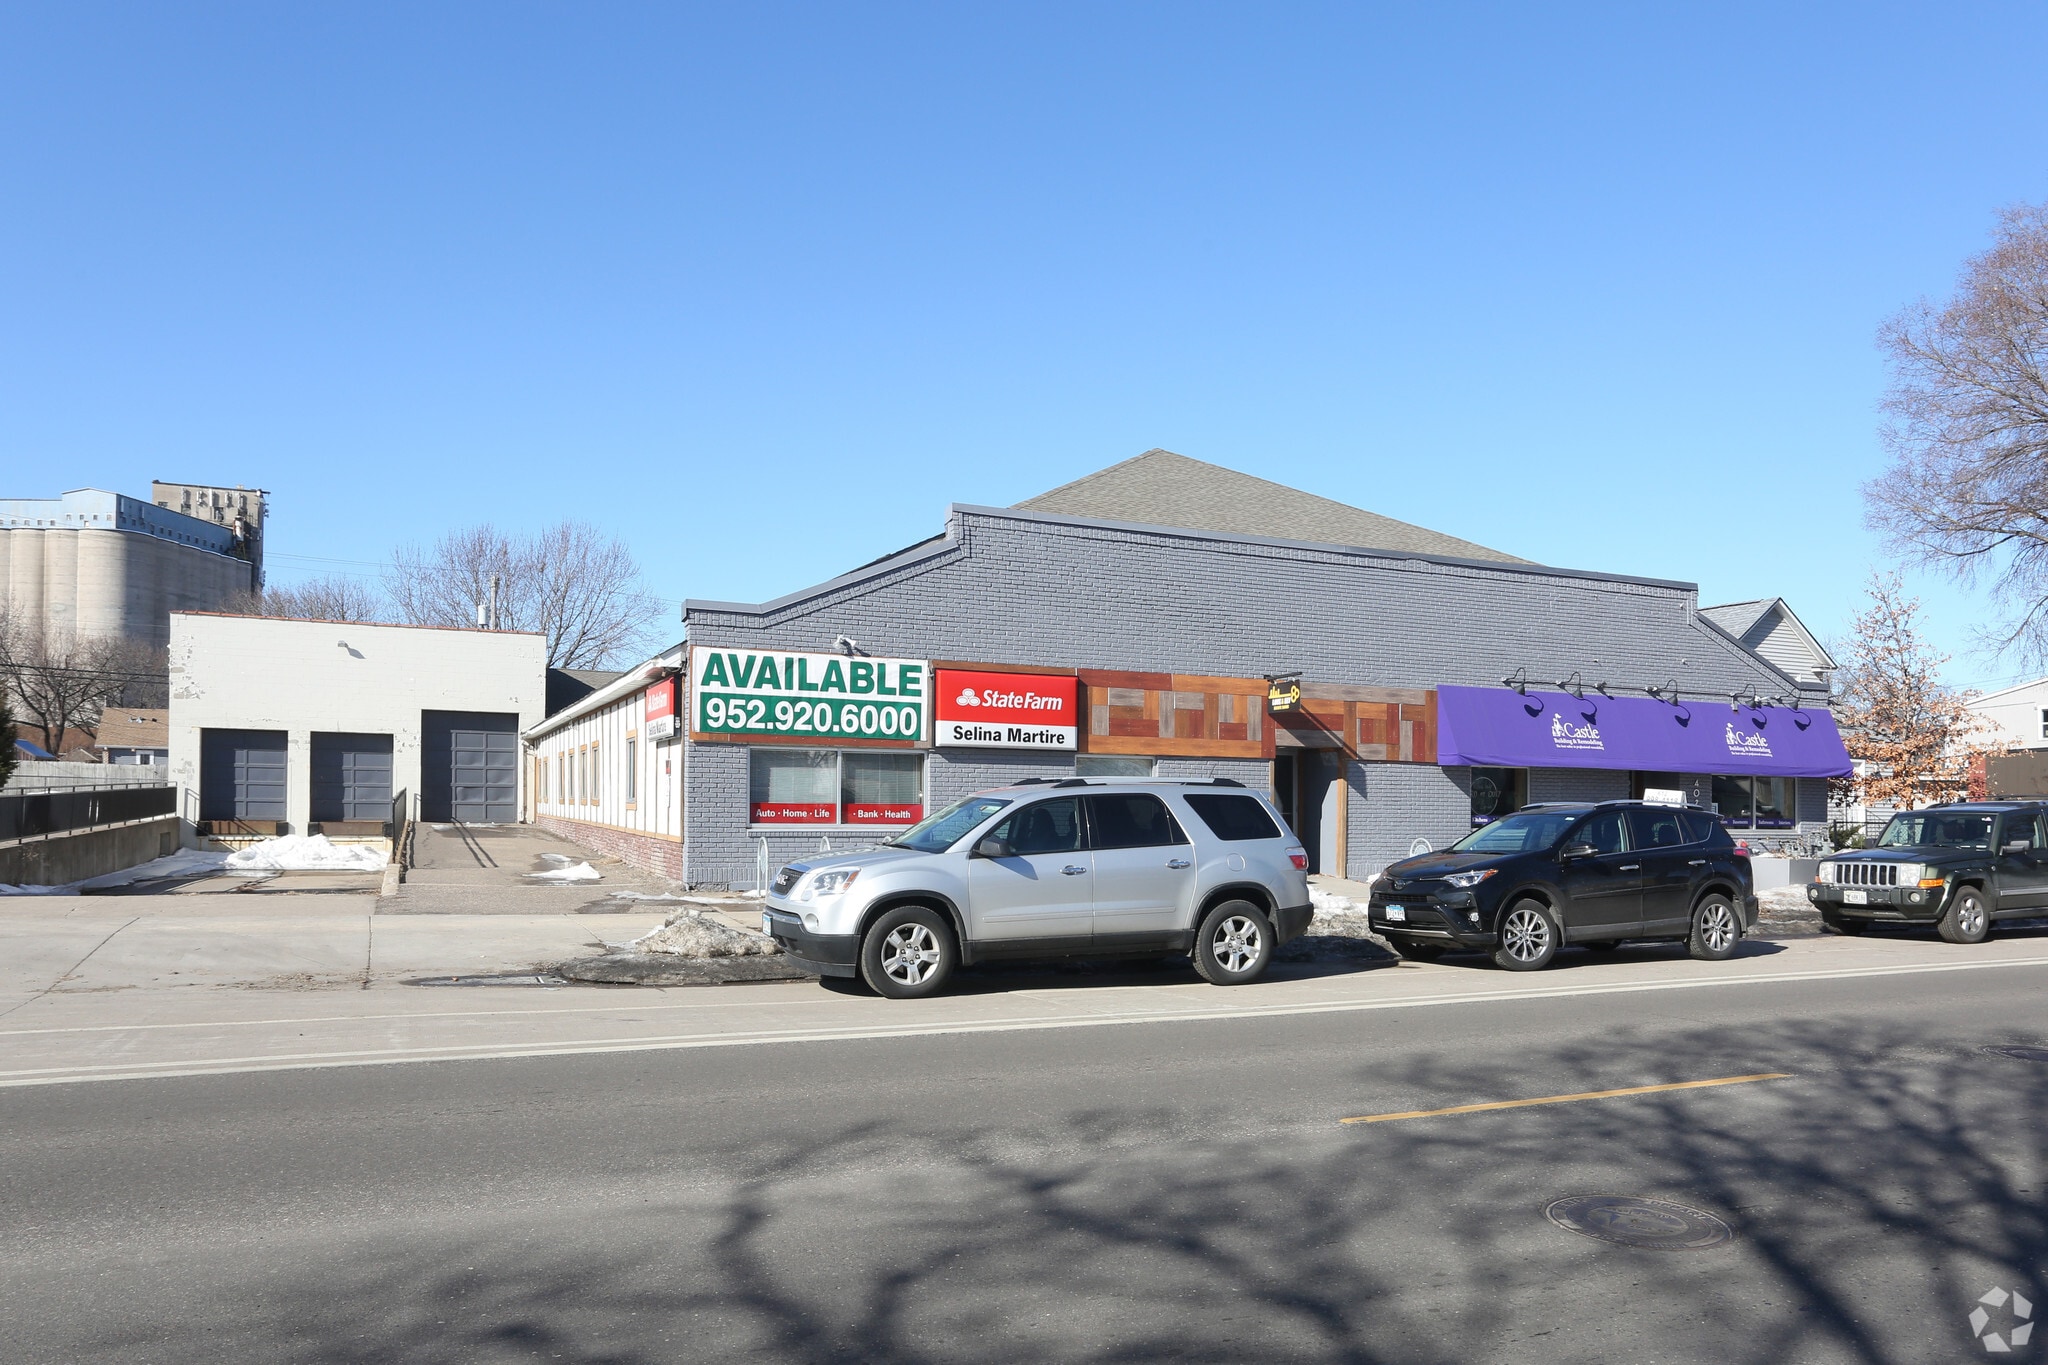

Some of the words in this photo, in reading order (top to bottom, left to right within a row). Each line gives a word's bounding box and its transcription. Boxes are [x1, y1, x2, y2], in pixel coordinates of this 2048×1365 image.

[701, 652, 922, 697] AVAILABLE
[706, 697, 918, 736] 952.920.6000
[953, 725, 1002, 742] Selina
[1007, 727, 1065, 744] Martire
[1563, 722, 1600, 739] Castle
[1735, 731, 1768, 747] Castle
[756, 808, 776, 817] Auto
[783, 808, 807, 817] Home
[814, 808, 830, 818] Life
[857, 809, 878, 818] Bank
[884, 809, 911, 819] Health
